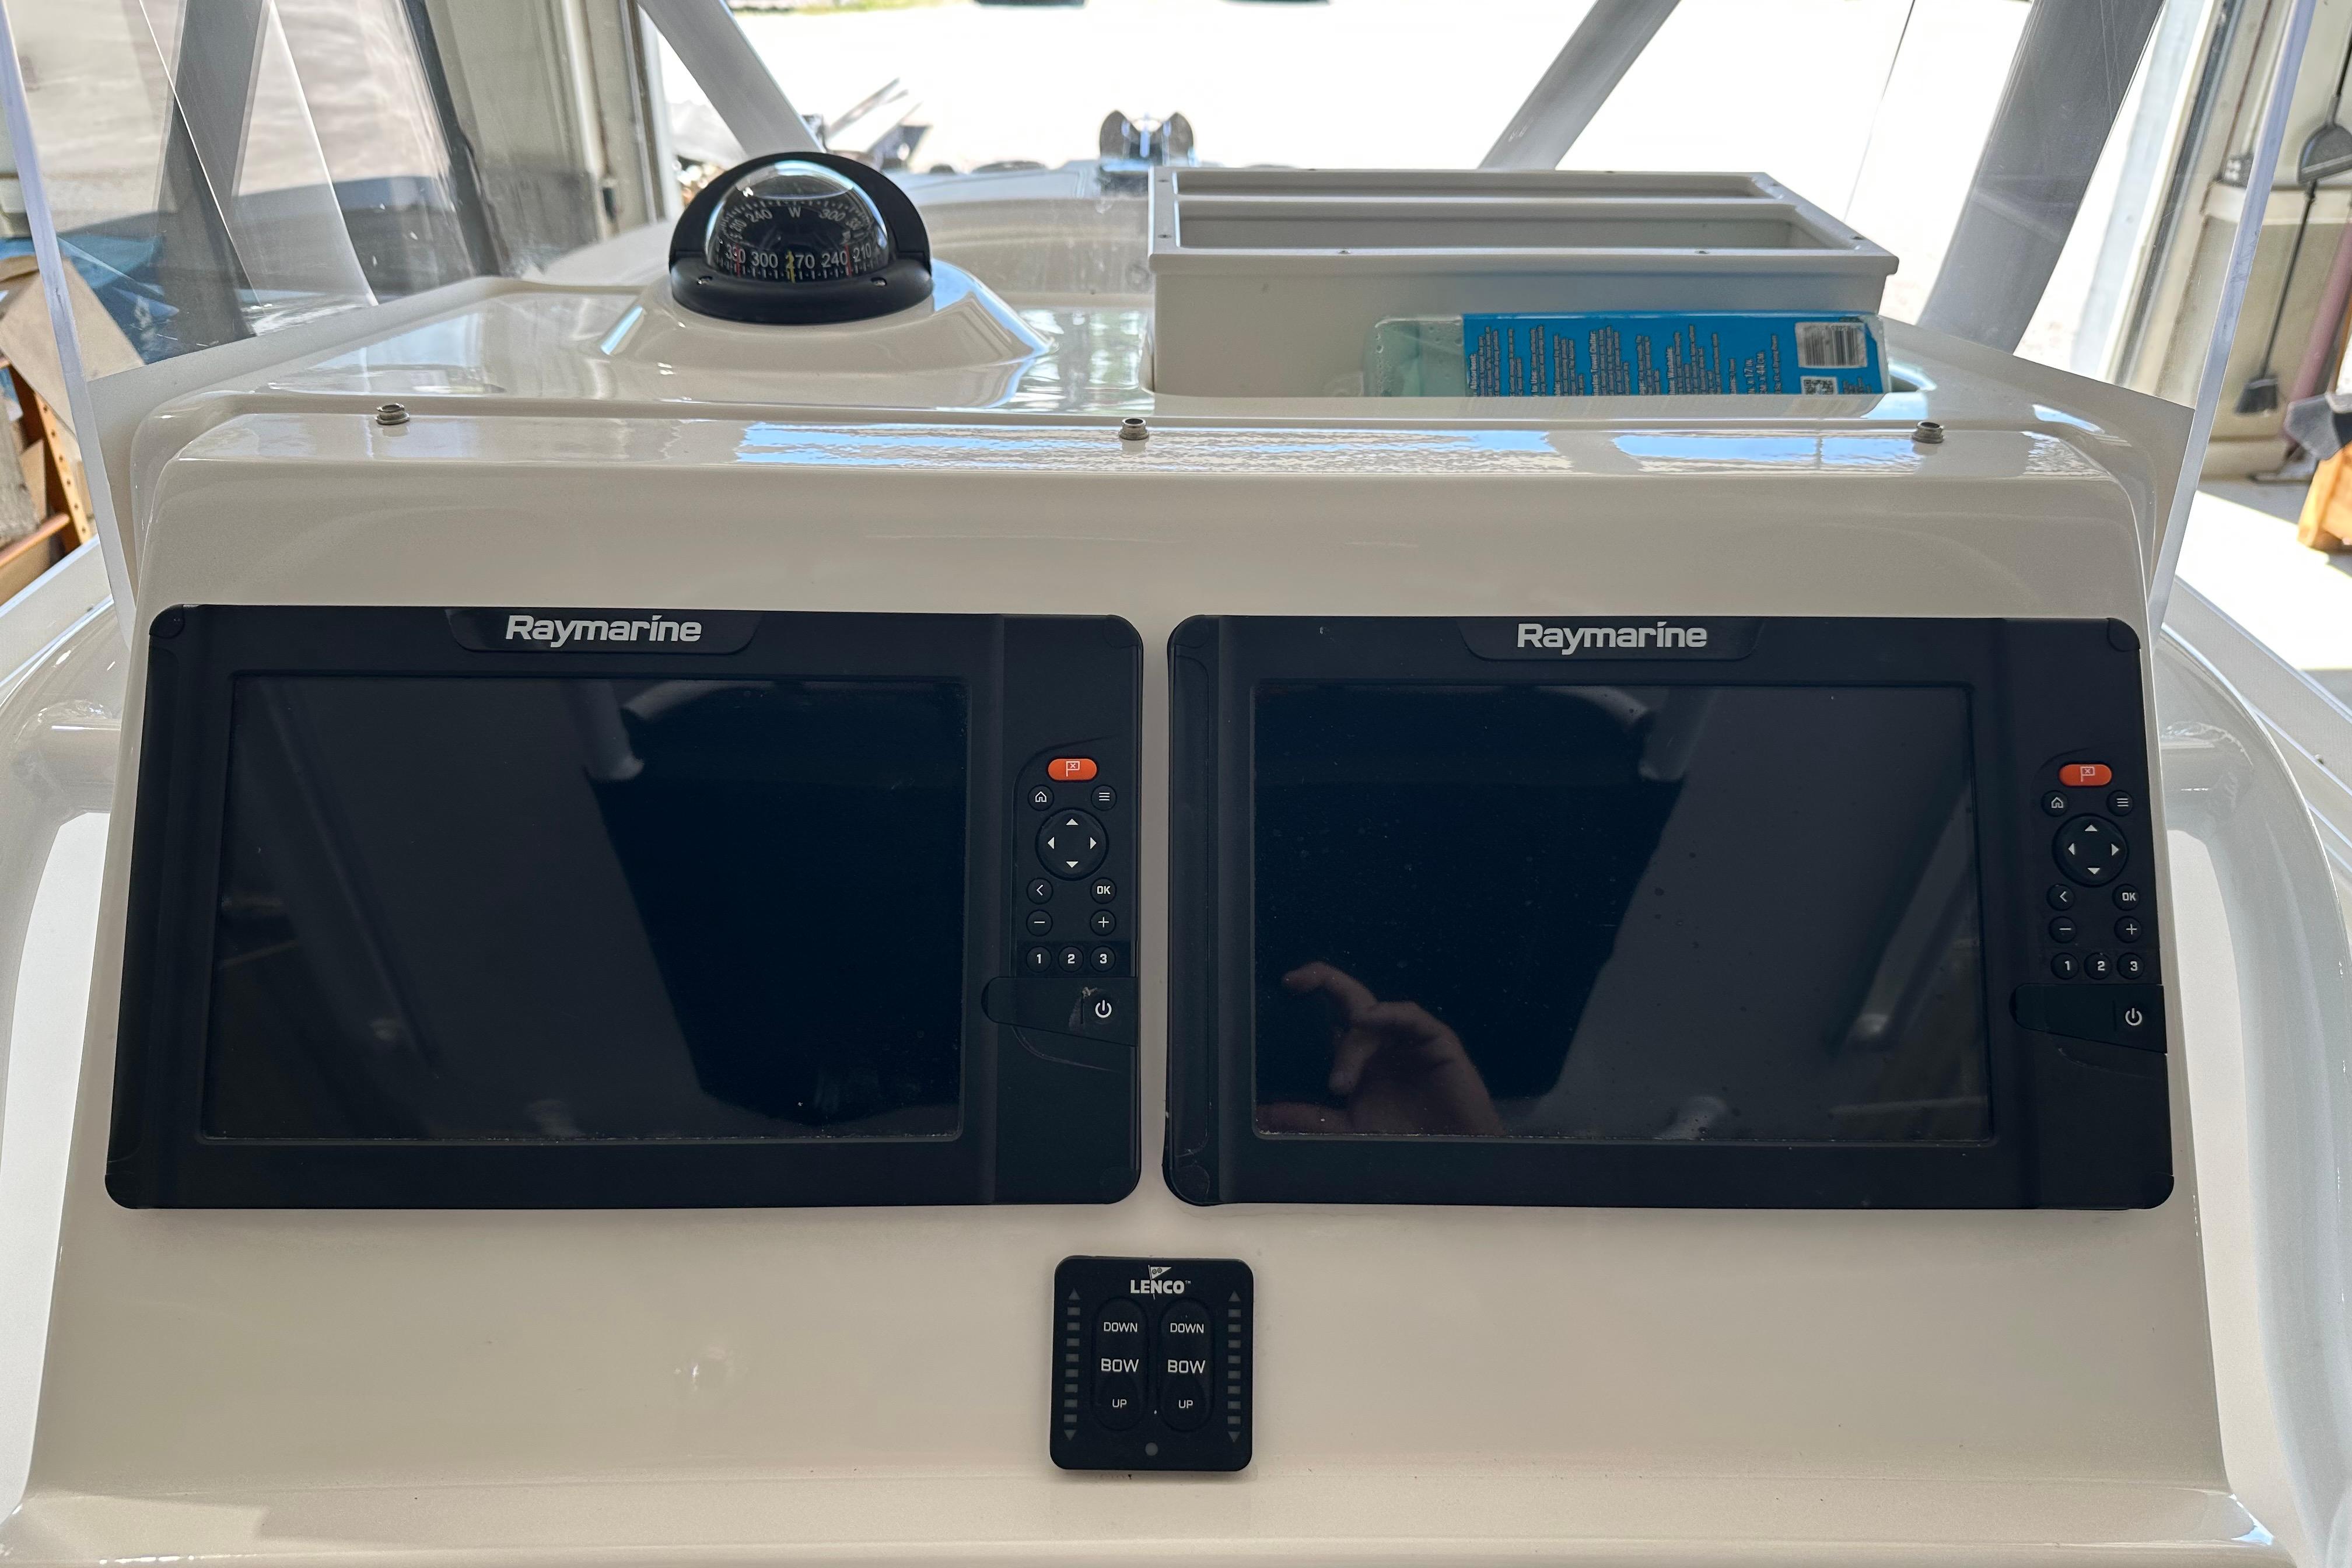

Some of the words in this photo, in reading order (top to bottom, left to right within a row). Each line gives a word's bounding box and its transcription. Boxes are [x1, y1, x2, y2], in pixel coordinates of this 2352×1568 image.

[744, 209, 773, 223] 240
[788, 206, 802, 218] W
[819, 208, 846, 222] 300
[751, 253, 779, 269] 300
[822, 250, 848, 268] 240
[853, 243, 873, 262] 210
[505, 615, 702, 648] Raymarine
[1517, 622, 1707, 655] Raymarine
[1097, 885, 1111, 895] OK
[2122, 892, 2136, 902] OK
[1036, 954, 1042, 964] 1
[1068, 954, 1075, 964] 2
[1100, 954, 1107, 964] 3
[2064, 961, 2070, 971] 1
[2098, 961, 2105, 971] 2
[2130, 961, 2138, 971] 3
[1103, 1321, 1138, 1333] DOWN
[1170, 1322, 1205, 1334] DOWN
[1101, 1358, 1139, 1373] BOW
[1167, 1359, 1206, 1374] BOW
[1112, 1399, 1127, 1408] UP
[1178, 1399, 1194, 1409] UP
